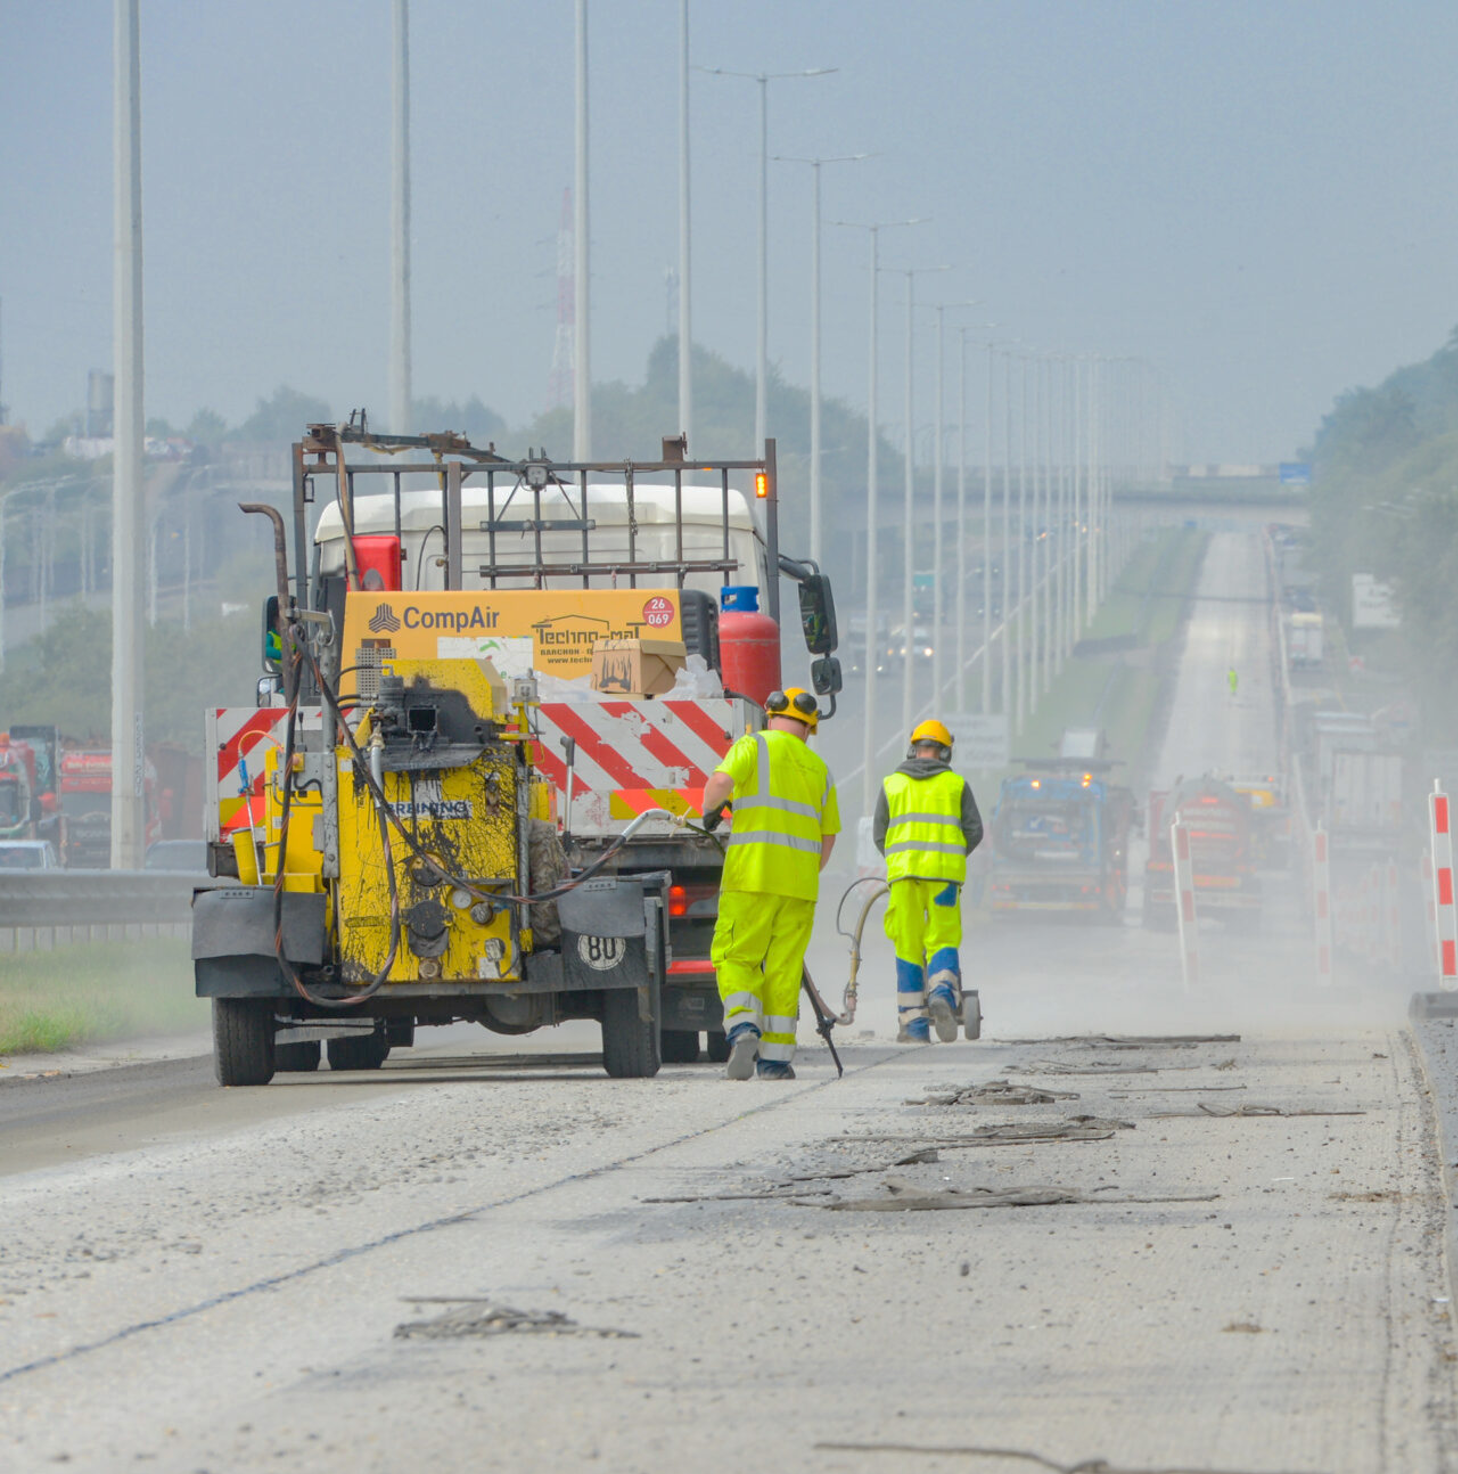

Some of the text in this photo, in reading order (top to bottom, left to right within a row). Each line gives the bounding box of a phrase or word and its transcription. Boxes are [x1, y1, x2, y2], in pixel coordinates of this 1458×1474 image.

[651, 599, 665, 610] 26
[403, 606, 500, 633] CompAir
[648, 614, 670, 625] 069
